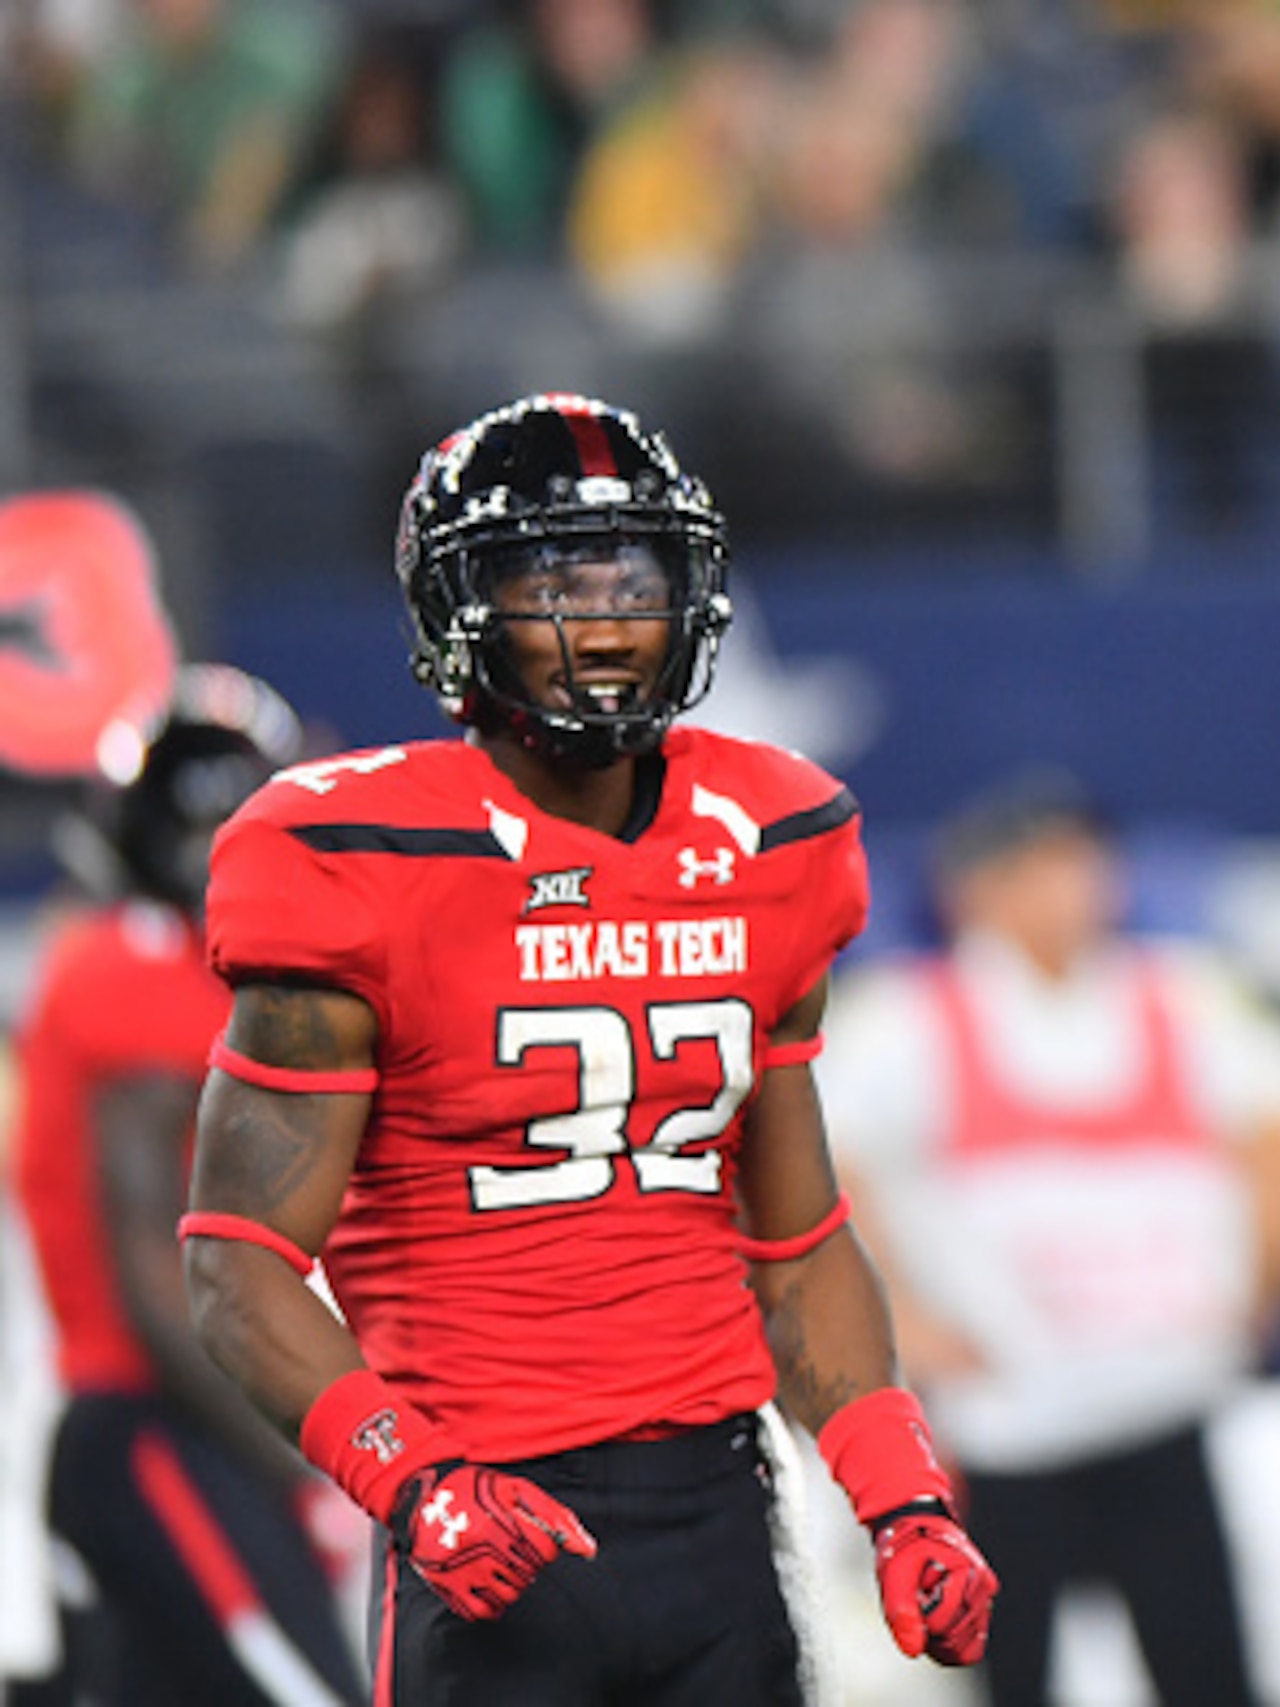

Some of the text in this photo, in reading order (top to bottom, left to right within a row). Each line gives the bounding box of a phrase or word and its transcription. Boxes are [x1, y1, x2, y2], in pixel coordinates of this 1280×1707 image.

[515, 917, 747, 981] TEXAS TECH
[467, 997, 755, 1213] 32
